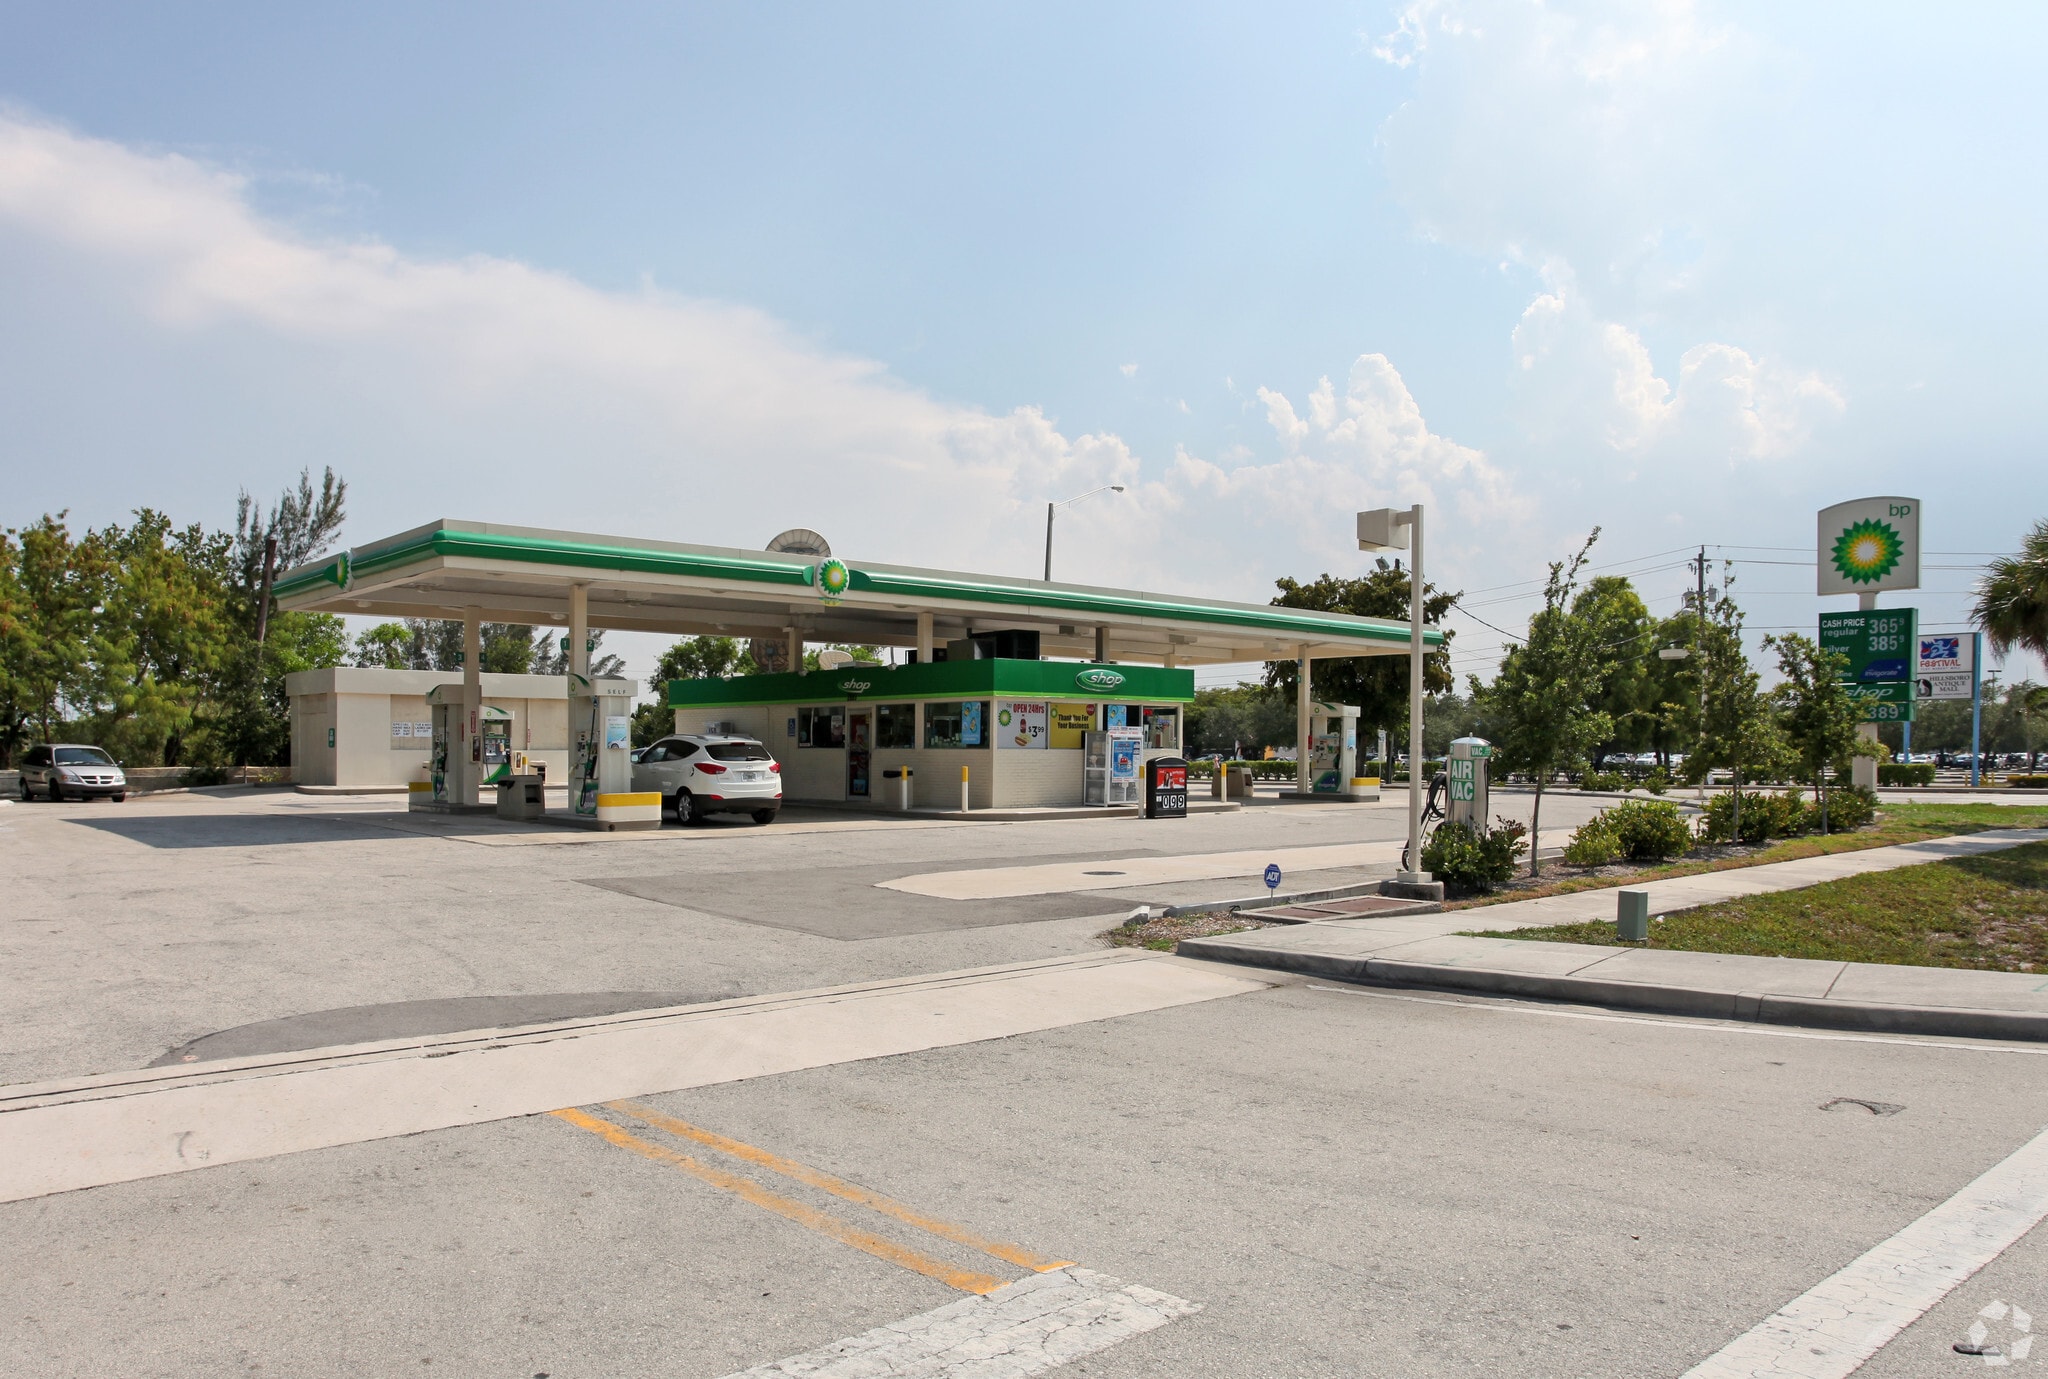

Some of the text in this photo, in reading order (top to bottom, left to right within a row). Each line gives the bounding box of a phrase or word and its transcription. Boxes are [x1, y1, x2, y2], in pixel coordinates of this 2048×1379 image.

[1889, 503, 1911, 519] bp
[1821, 617, 1866, 629] CASH PRICE
[1823, 627, 1859, 638] regular
[842, 678, 871, 693] shop
[1090, 672, 1123, 688] shop
[1013, 703, 1027, 713] OPEN
[1471, 747, 1483, 756] VAC
[1451, 760, 1473, 779] AIR
[1451, 781, 1474, 801] VAC
